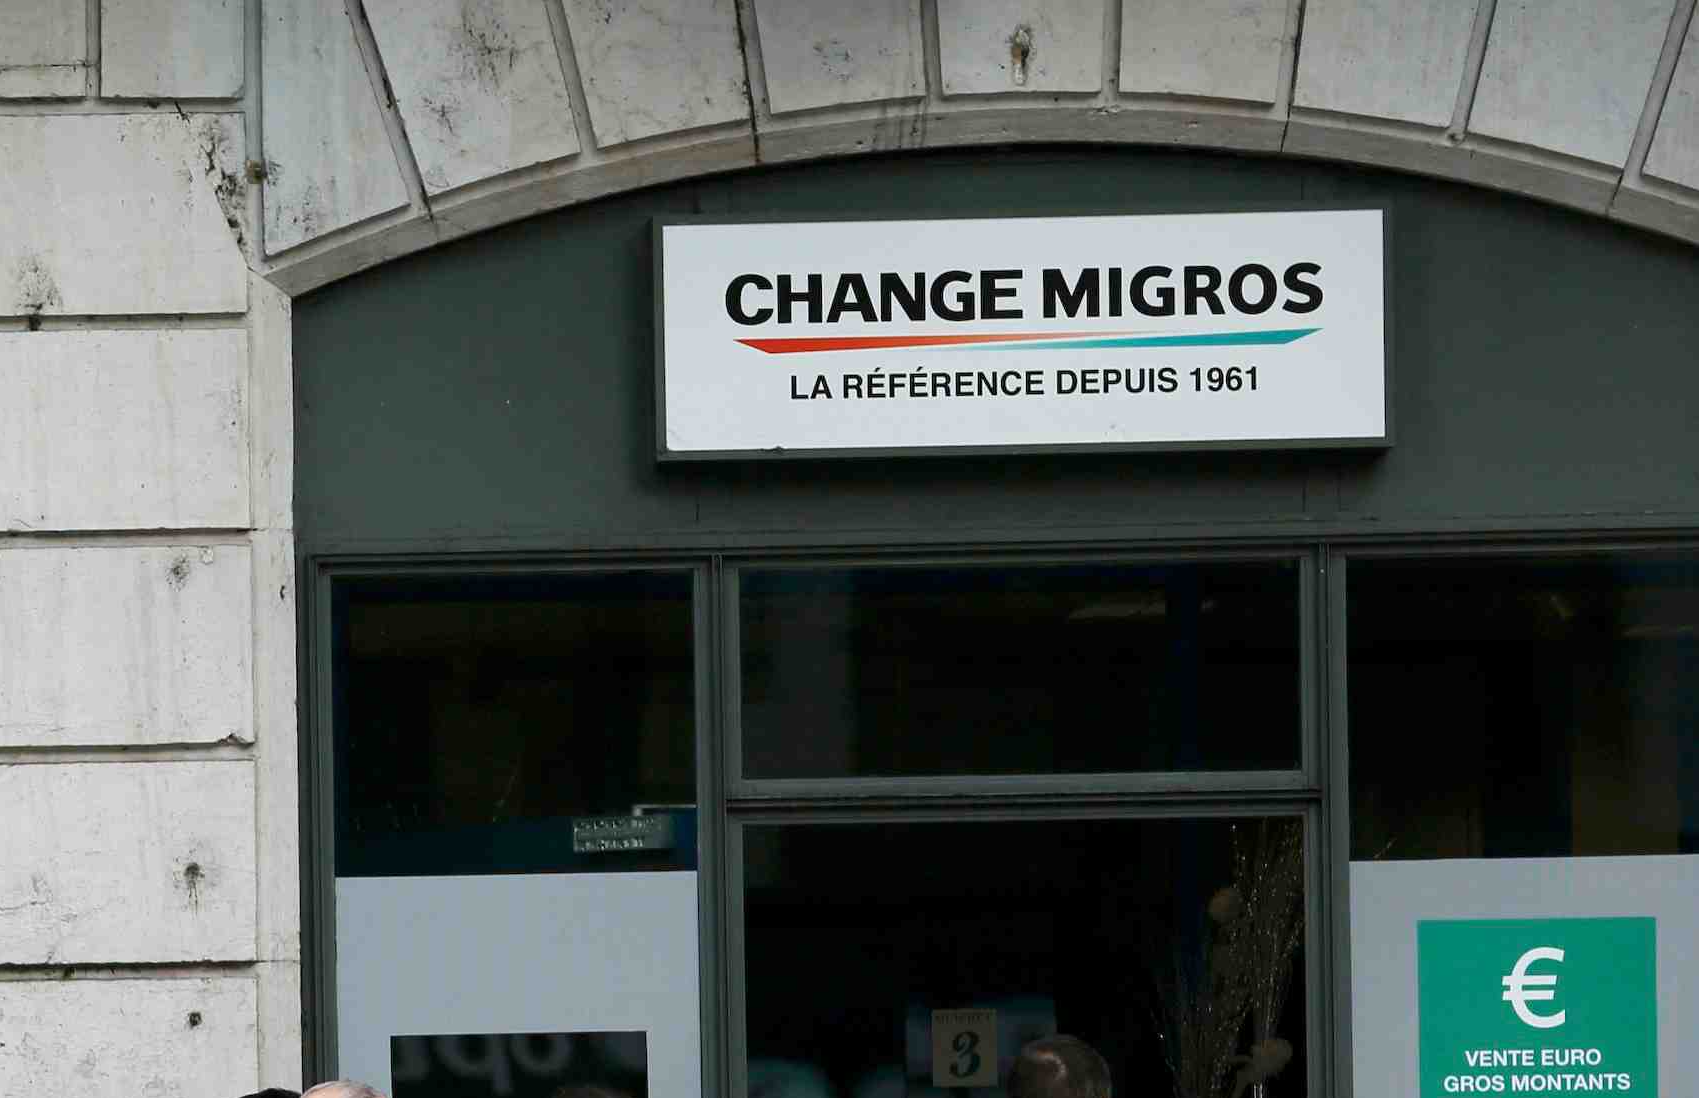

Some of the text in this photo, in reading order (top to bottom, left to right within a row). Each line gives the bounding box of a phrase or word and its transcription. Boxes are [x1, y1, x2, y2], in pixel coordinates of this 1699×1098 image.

[726, 263, 1323, 325] CHANGE MIGROS
[791, 366, 1256, 399] LA RÉFÉRENCE DEPUIS 1961
[1502, 947, 1565, 1028] €
[949, 1030, 981, 1078] 3
[1465, 1049, 1601, 1066] VENTE EURO
[1444, 1074, 1630, 1092] GROS MONTANTS
